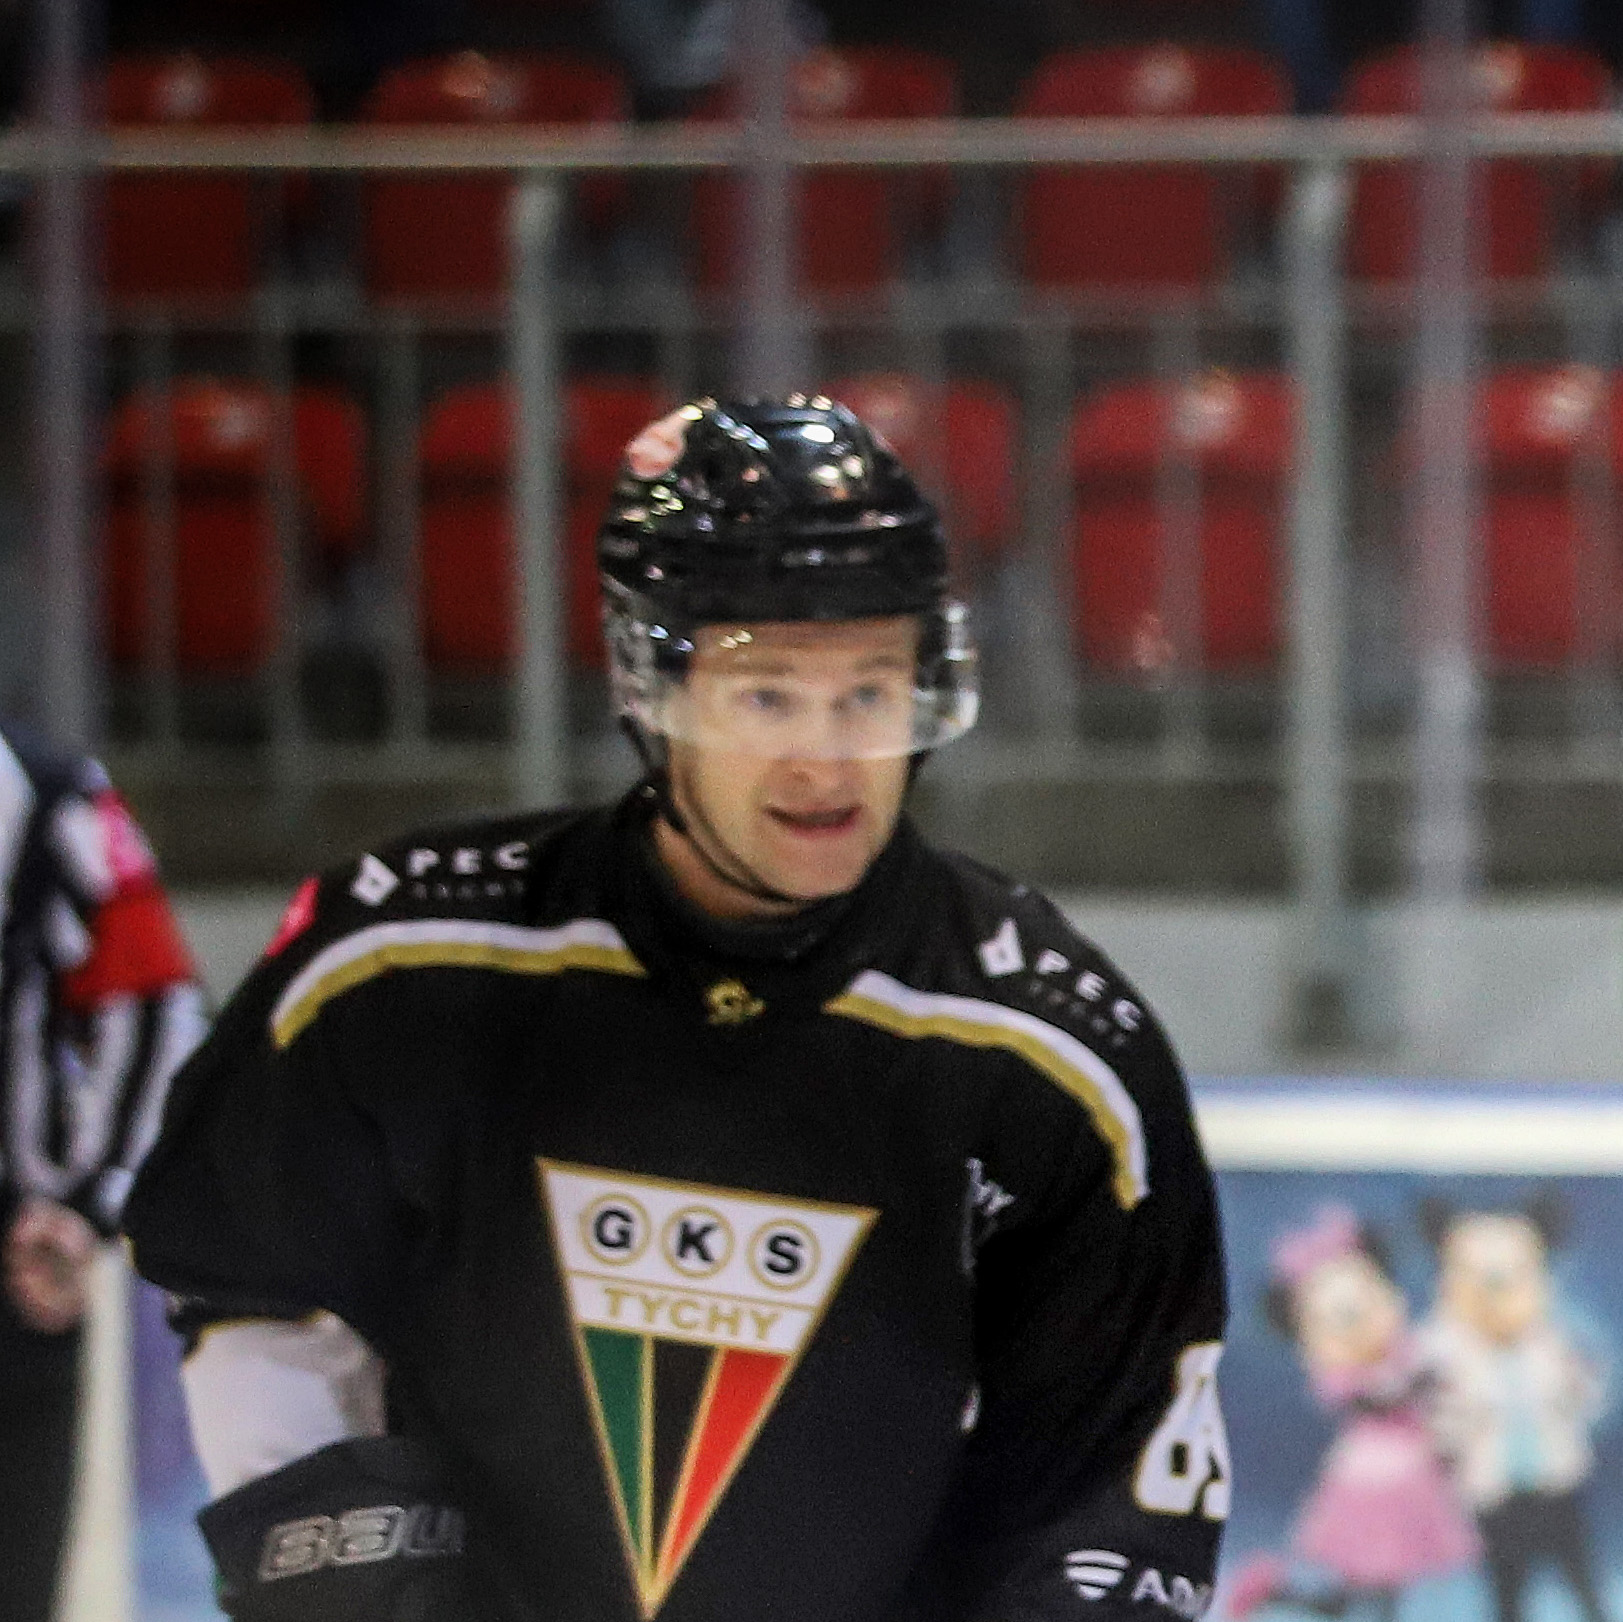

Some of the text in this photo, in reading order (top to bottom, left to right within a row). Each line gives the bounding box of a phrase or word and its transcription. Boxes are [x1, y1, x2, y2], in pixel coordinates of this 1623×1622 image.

[405, 842, 529, 877] PEC
[594, 1207, 801, 1275] GKS
[604, 1288, 779, 1341] TYCHY
